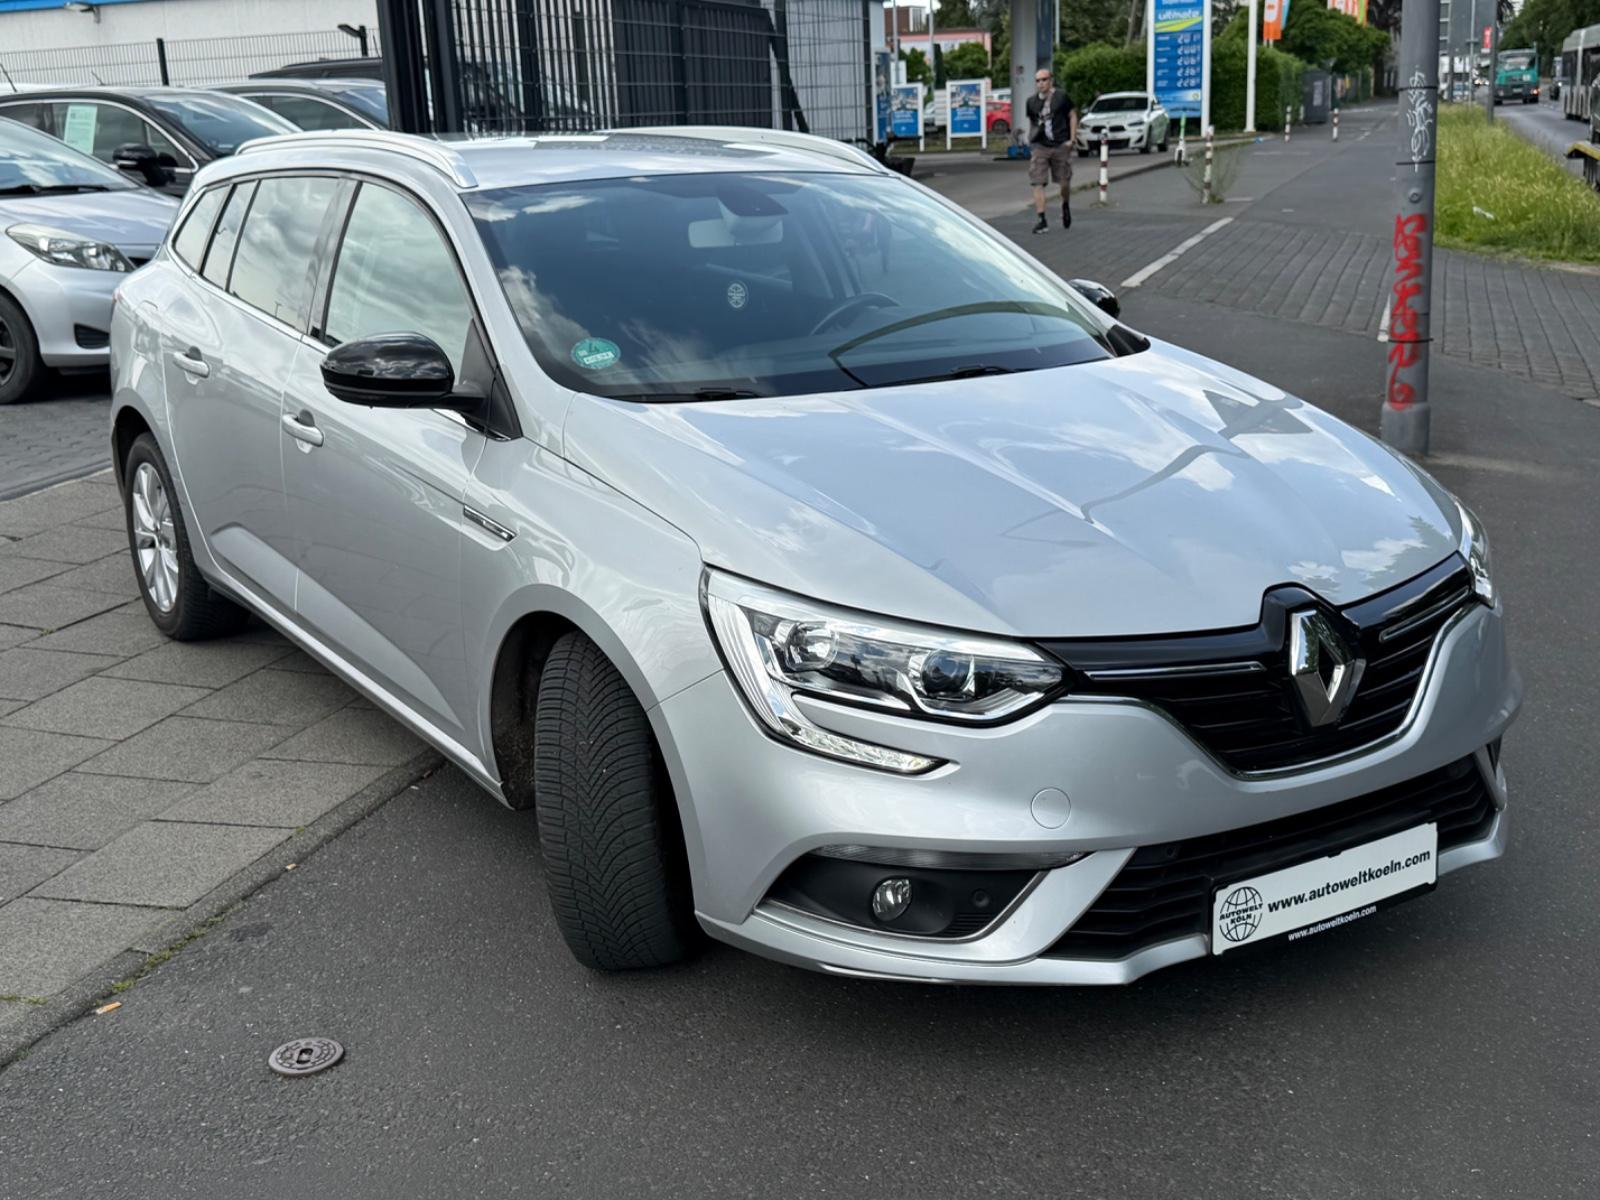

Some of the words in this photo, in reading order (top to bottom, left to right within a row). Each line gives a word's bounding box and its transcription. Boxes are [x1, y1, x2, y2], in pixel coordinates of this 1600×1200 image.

[1267, 850, 1431, 913] www.autoweltkoeln.com
[1219, 902, 1264, 920] AUTOWELT
[1230, 912, 1253, 925] KÖLN
[1288, 904, 1377, 942] www.autoweltkoeln.com
